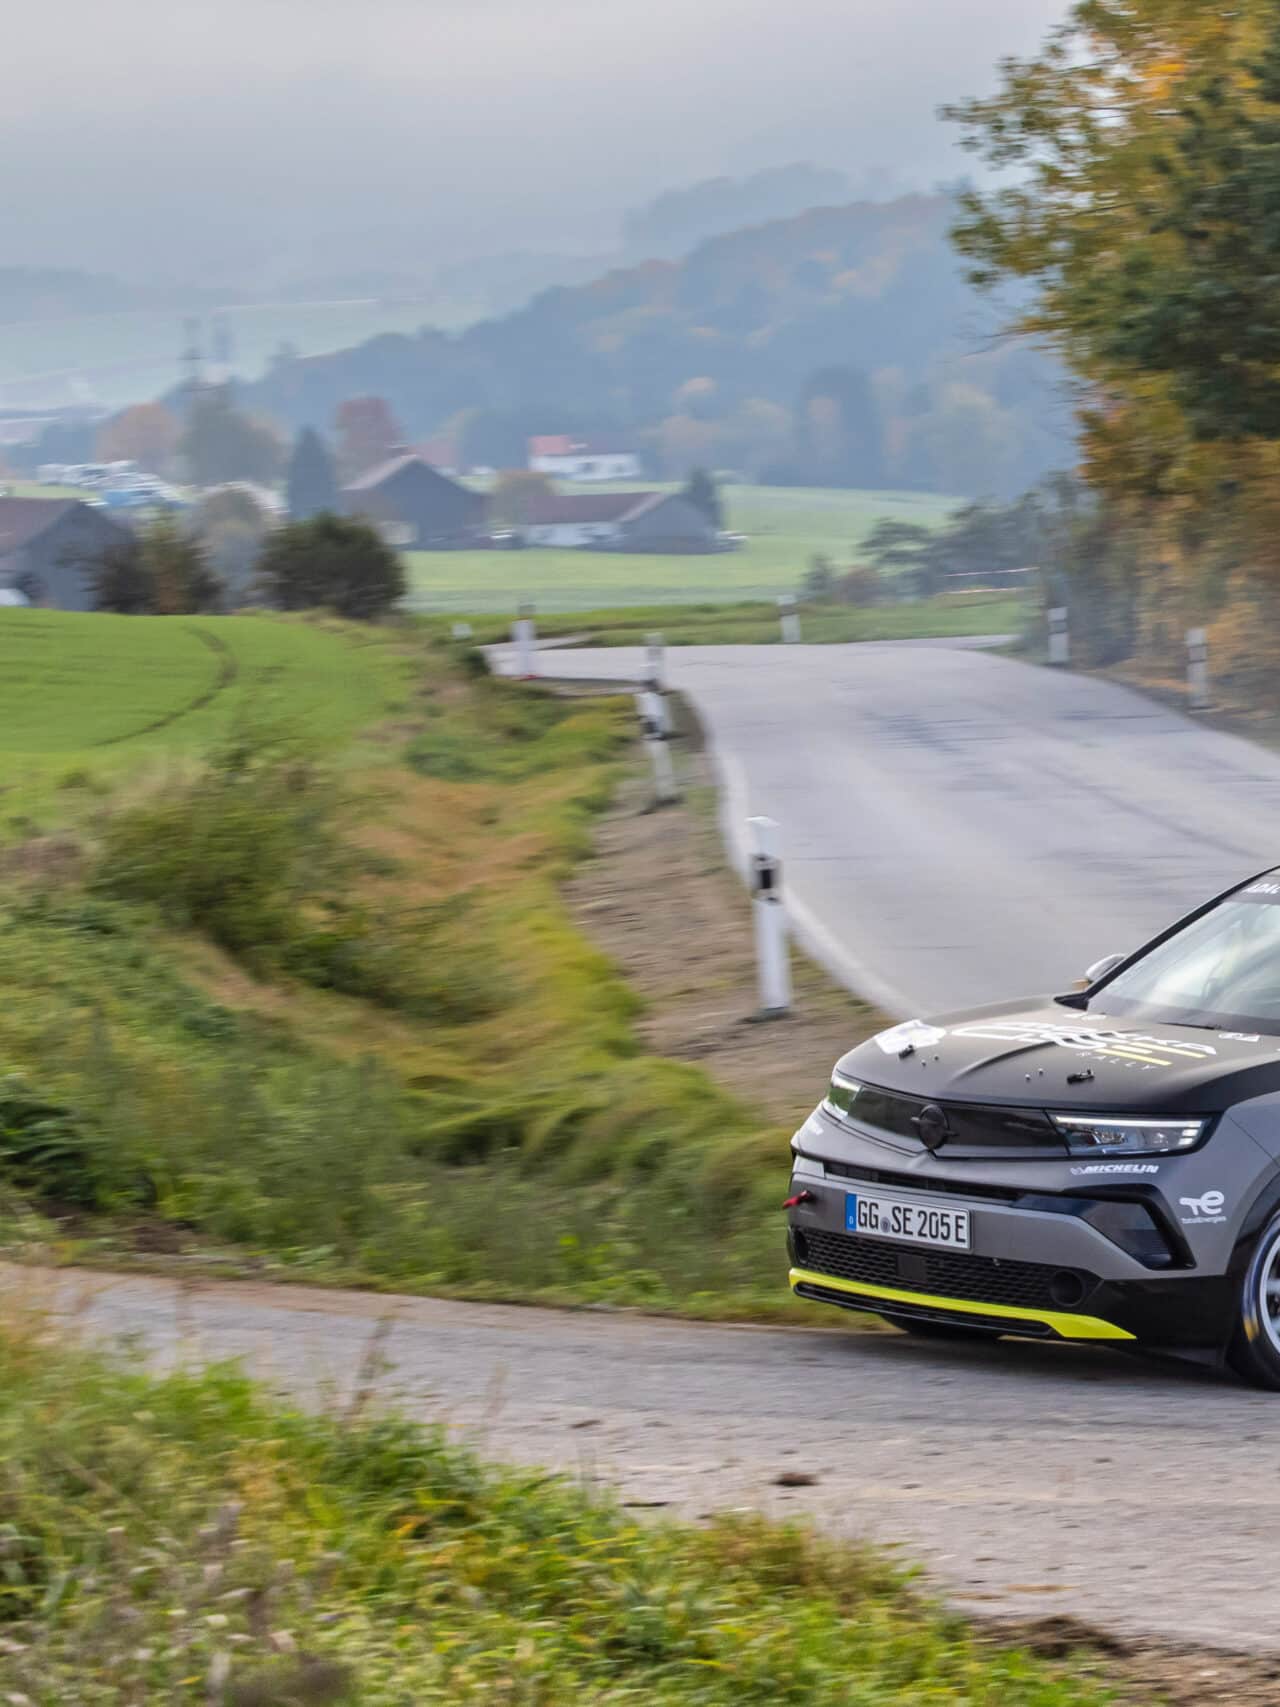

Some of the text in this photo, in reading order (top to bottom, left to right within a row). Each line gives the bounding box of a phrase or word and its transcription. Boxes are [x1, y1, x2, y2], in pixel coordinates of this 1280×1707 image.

[1085, 1163, 1160, 1175] MICHELIN
[857, 1199, 880, 1230] GG
[891, 1206, 914, 1236] SE
